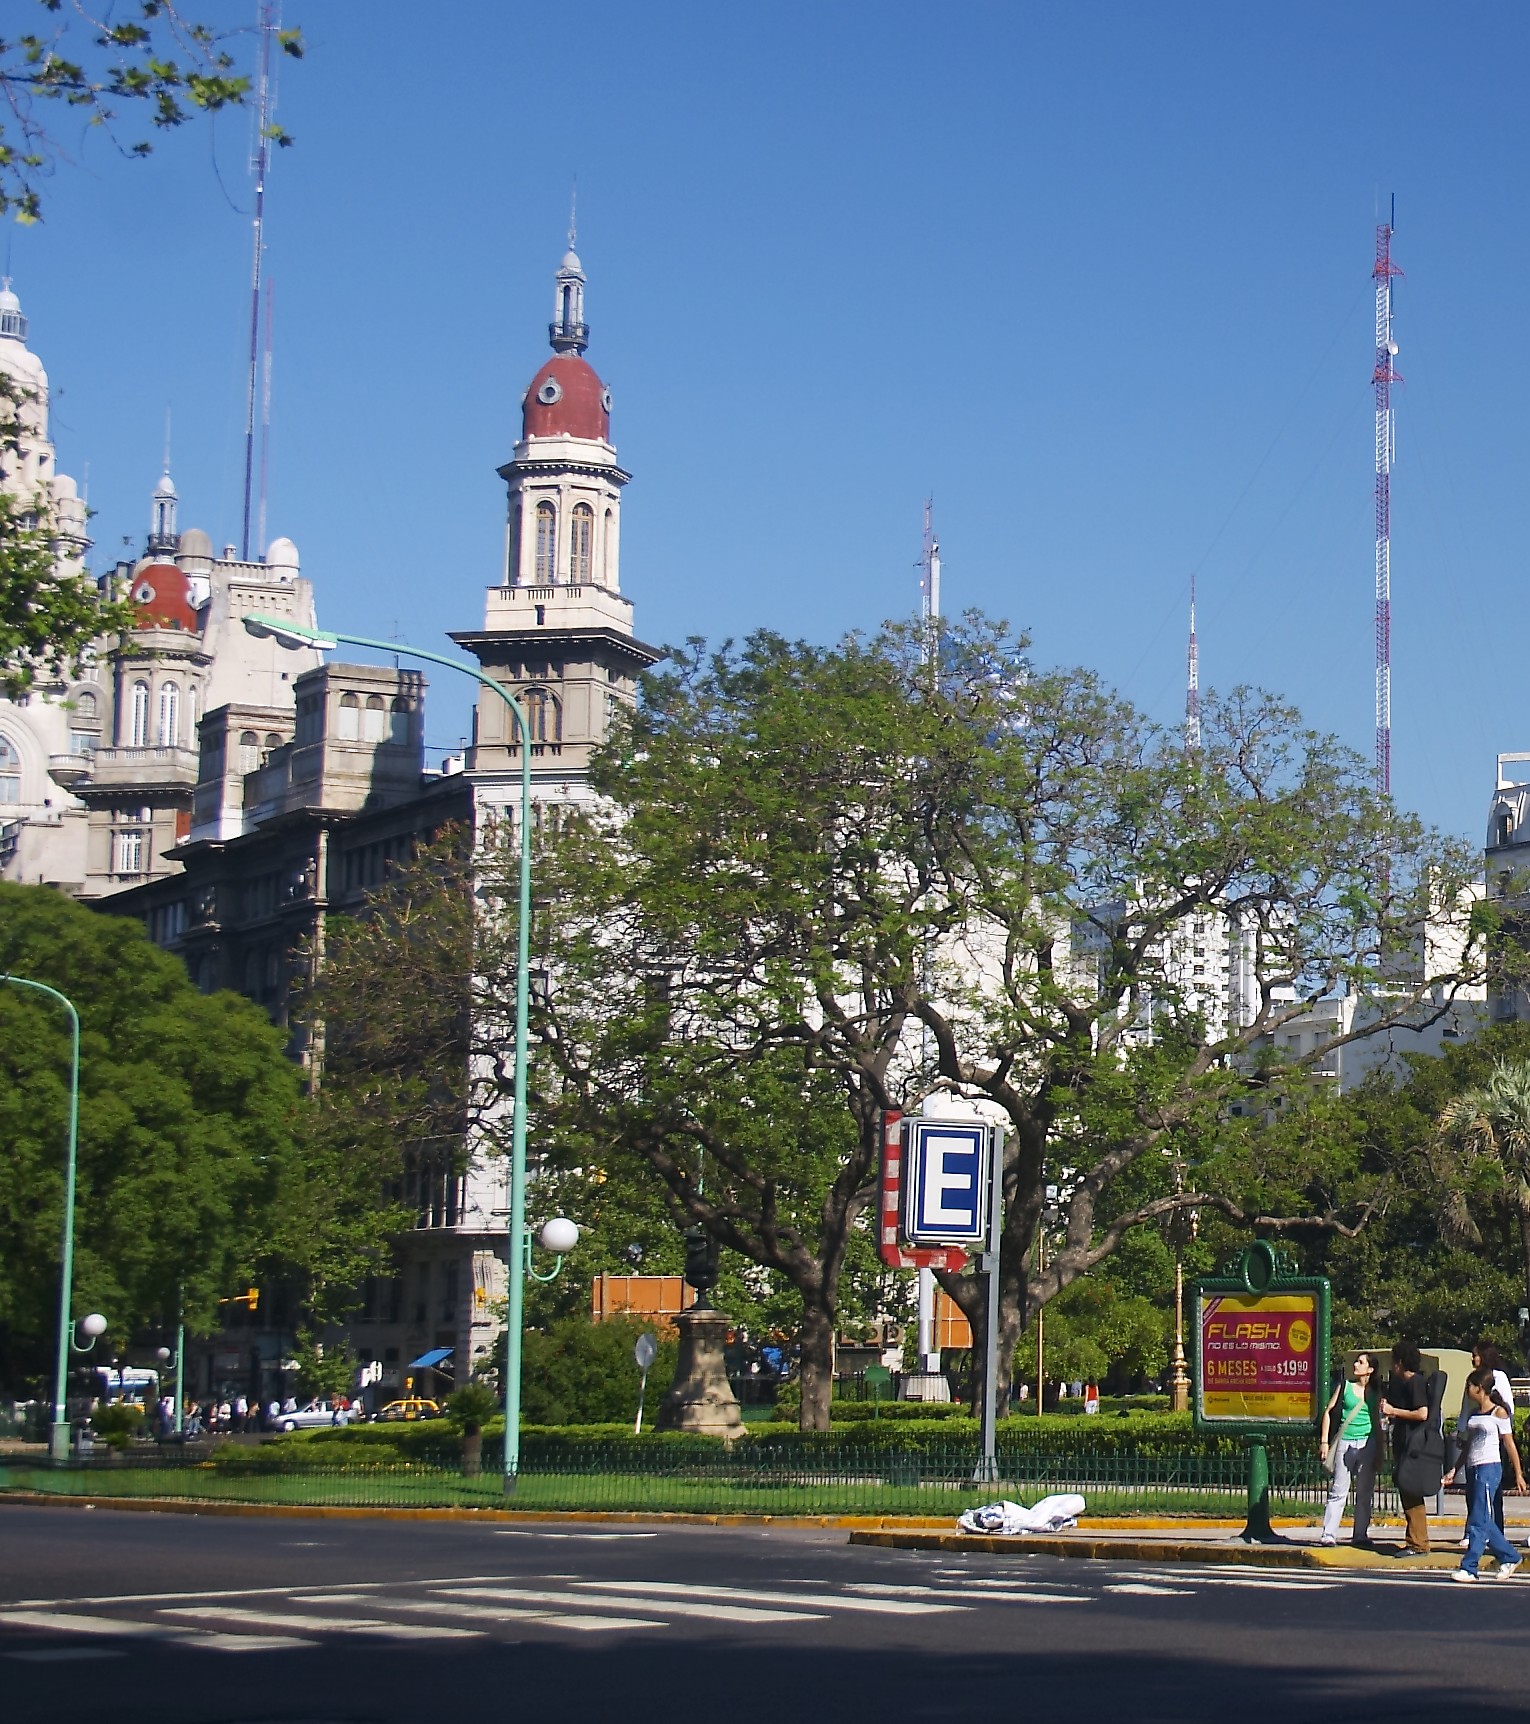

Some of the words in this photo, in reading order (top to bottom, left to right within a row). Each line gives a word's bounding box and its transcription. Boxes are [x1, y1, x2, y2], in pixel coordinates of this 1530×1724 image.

[923, 1136, 976, 1226] E
[1208, 1323, 1281, 1338] FLASH
[1207, 1360, 1215, 1376] 6
[1218, 1360, 1258, 1376] MESES
